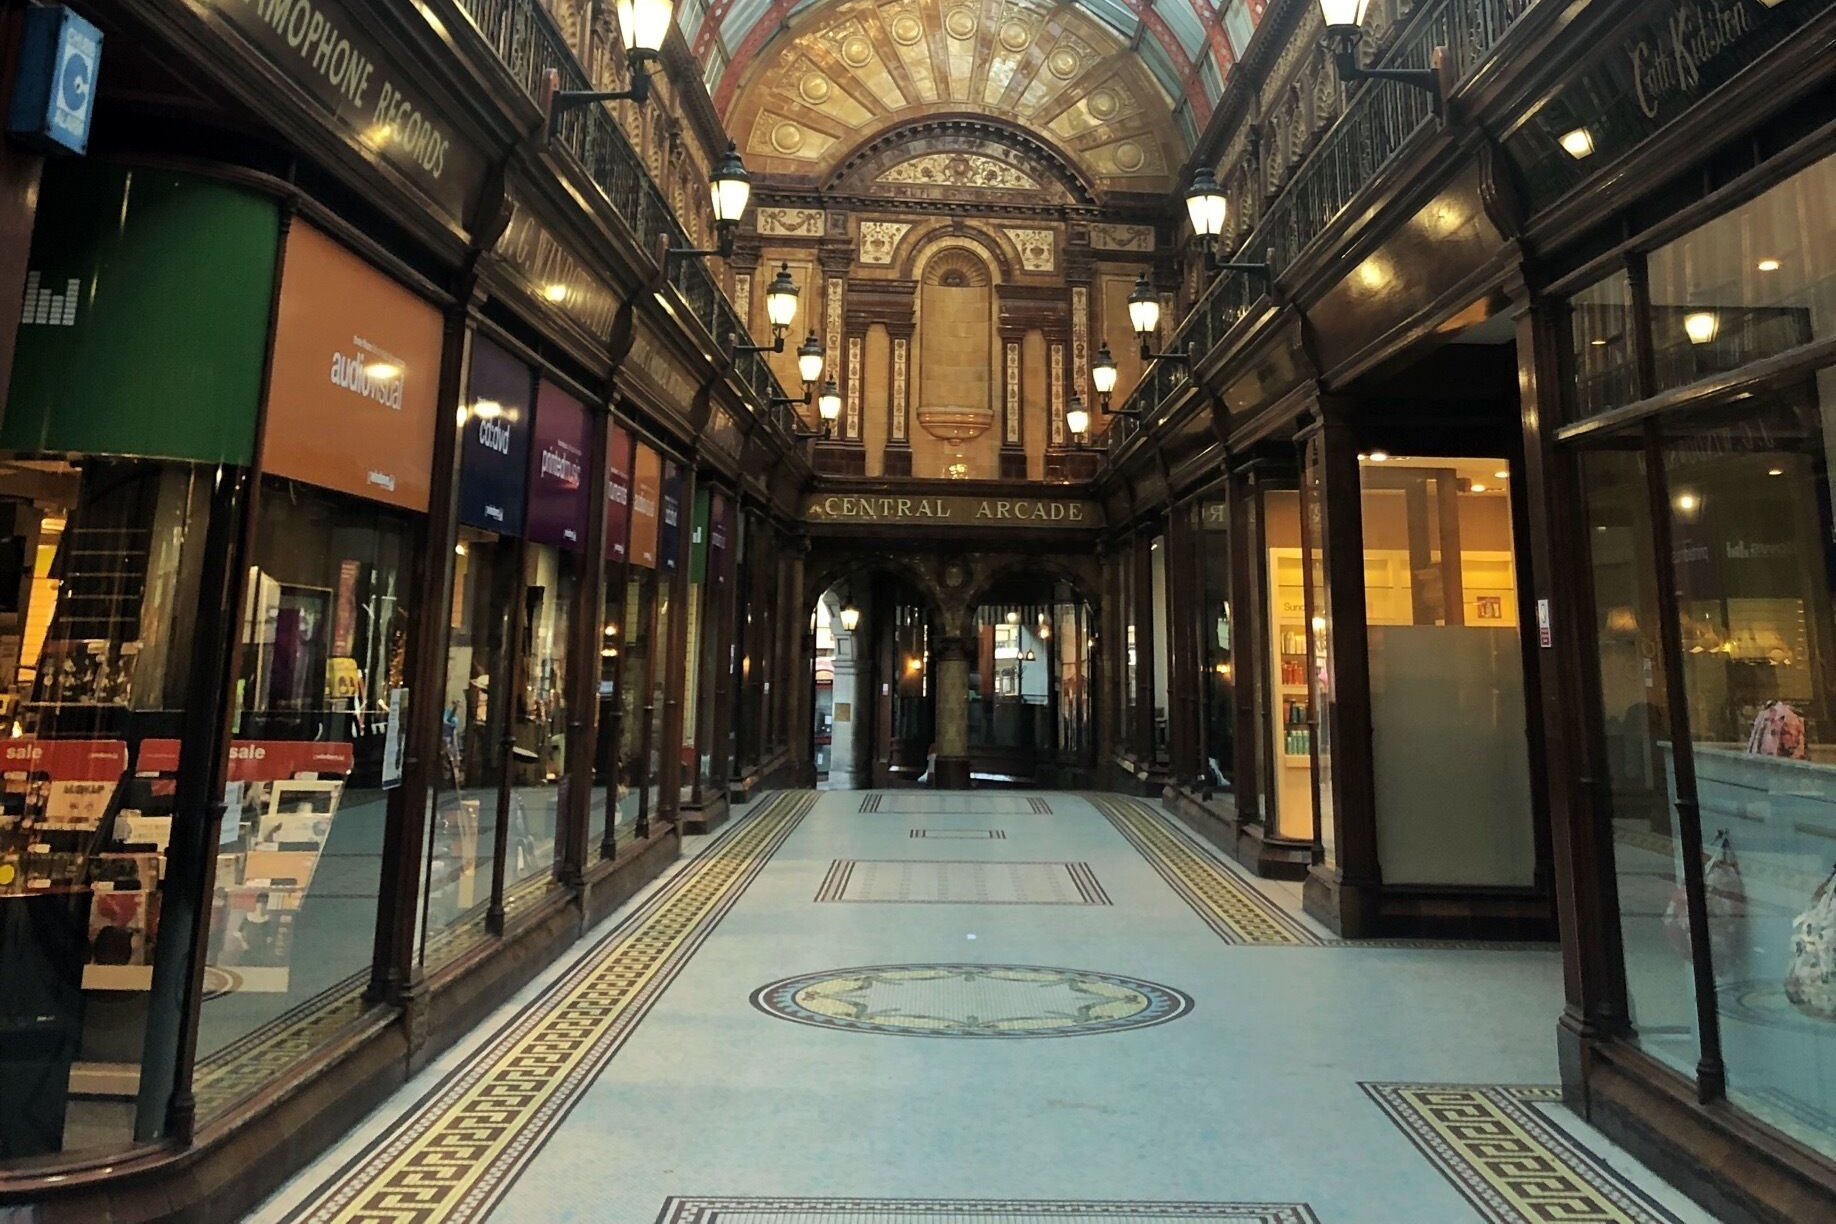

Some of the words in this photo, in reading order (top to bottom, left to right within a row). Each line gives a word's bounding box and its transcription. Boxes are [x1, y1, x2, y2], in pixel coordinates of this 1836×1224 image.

[1624, 39, 1677, 118] Cath
[373, 81, 449, 178] RECORDS
[825, 497, 950, 517] CENTRAL
[976, 501, 1083, 520] ARCADE
[6, 744, 43, 760] sale
[229, 743, 266, 760] sale
